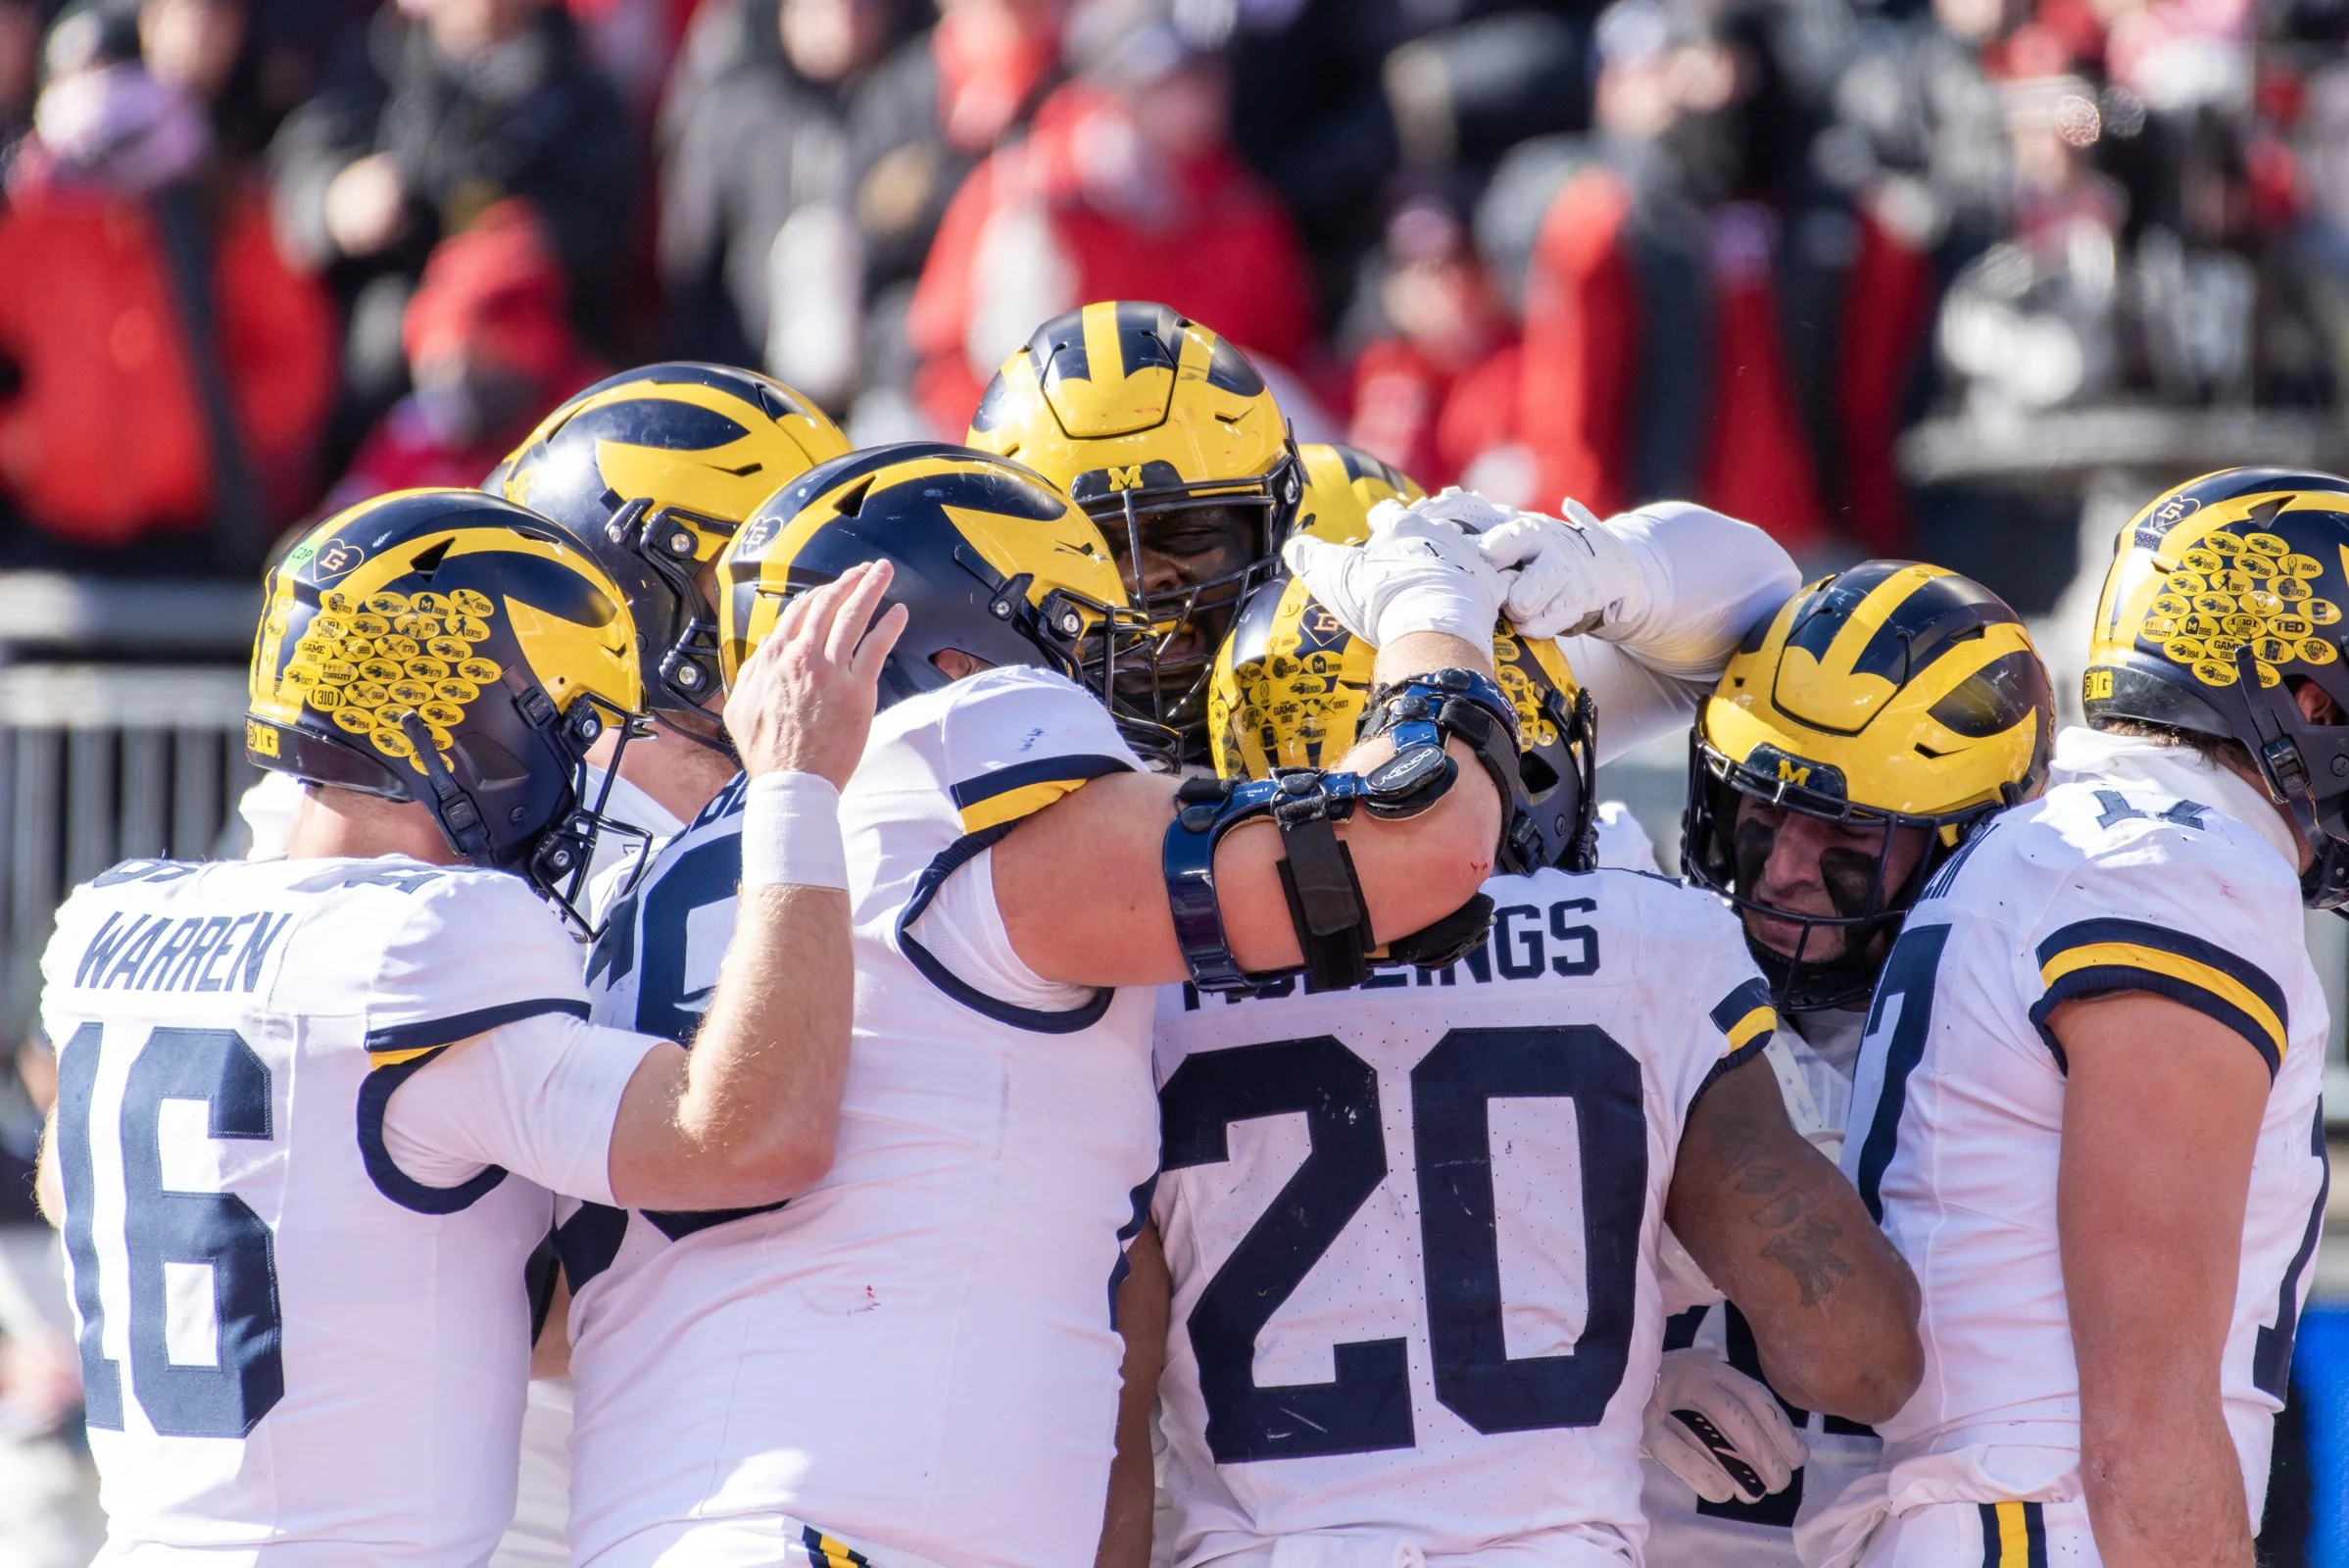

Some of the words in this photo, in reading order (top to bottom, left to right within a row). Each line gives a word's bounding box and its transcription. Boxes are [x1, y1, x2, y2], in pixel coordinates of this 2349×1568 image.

[1108, 466, 1144, 491] M
[319, 548, 348, 571] G
[2203, 561, 2215, 570] 992
[2301, 563, 2317, 572] 1004
[2275, 618, 2306, 634] TED
[302, 643, 325, 655] GAME
[1273, 704, 1298, 715] GAME
[1380, 748, 1434, 785] DONJOY
[1778, 759, 1811, 787] M
[73, 910, 293, 993] WARREN
[57, 1021, 284, 1439] 16
[1159, 1023, 1648, 1464] 20
